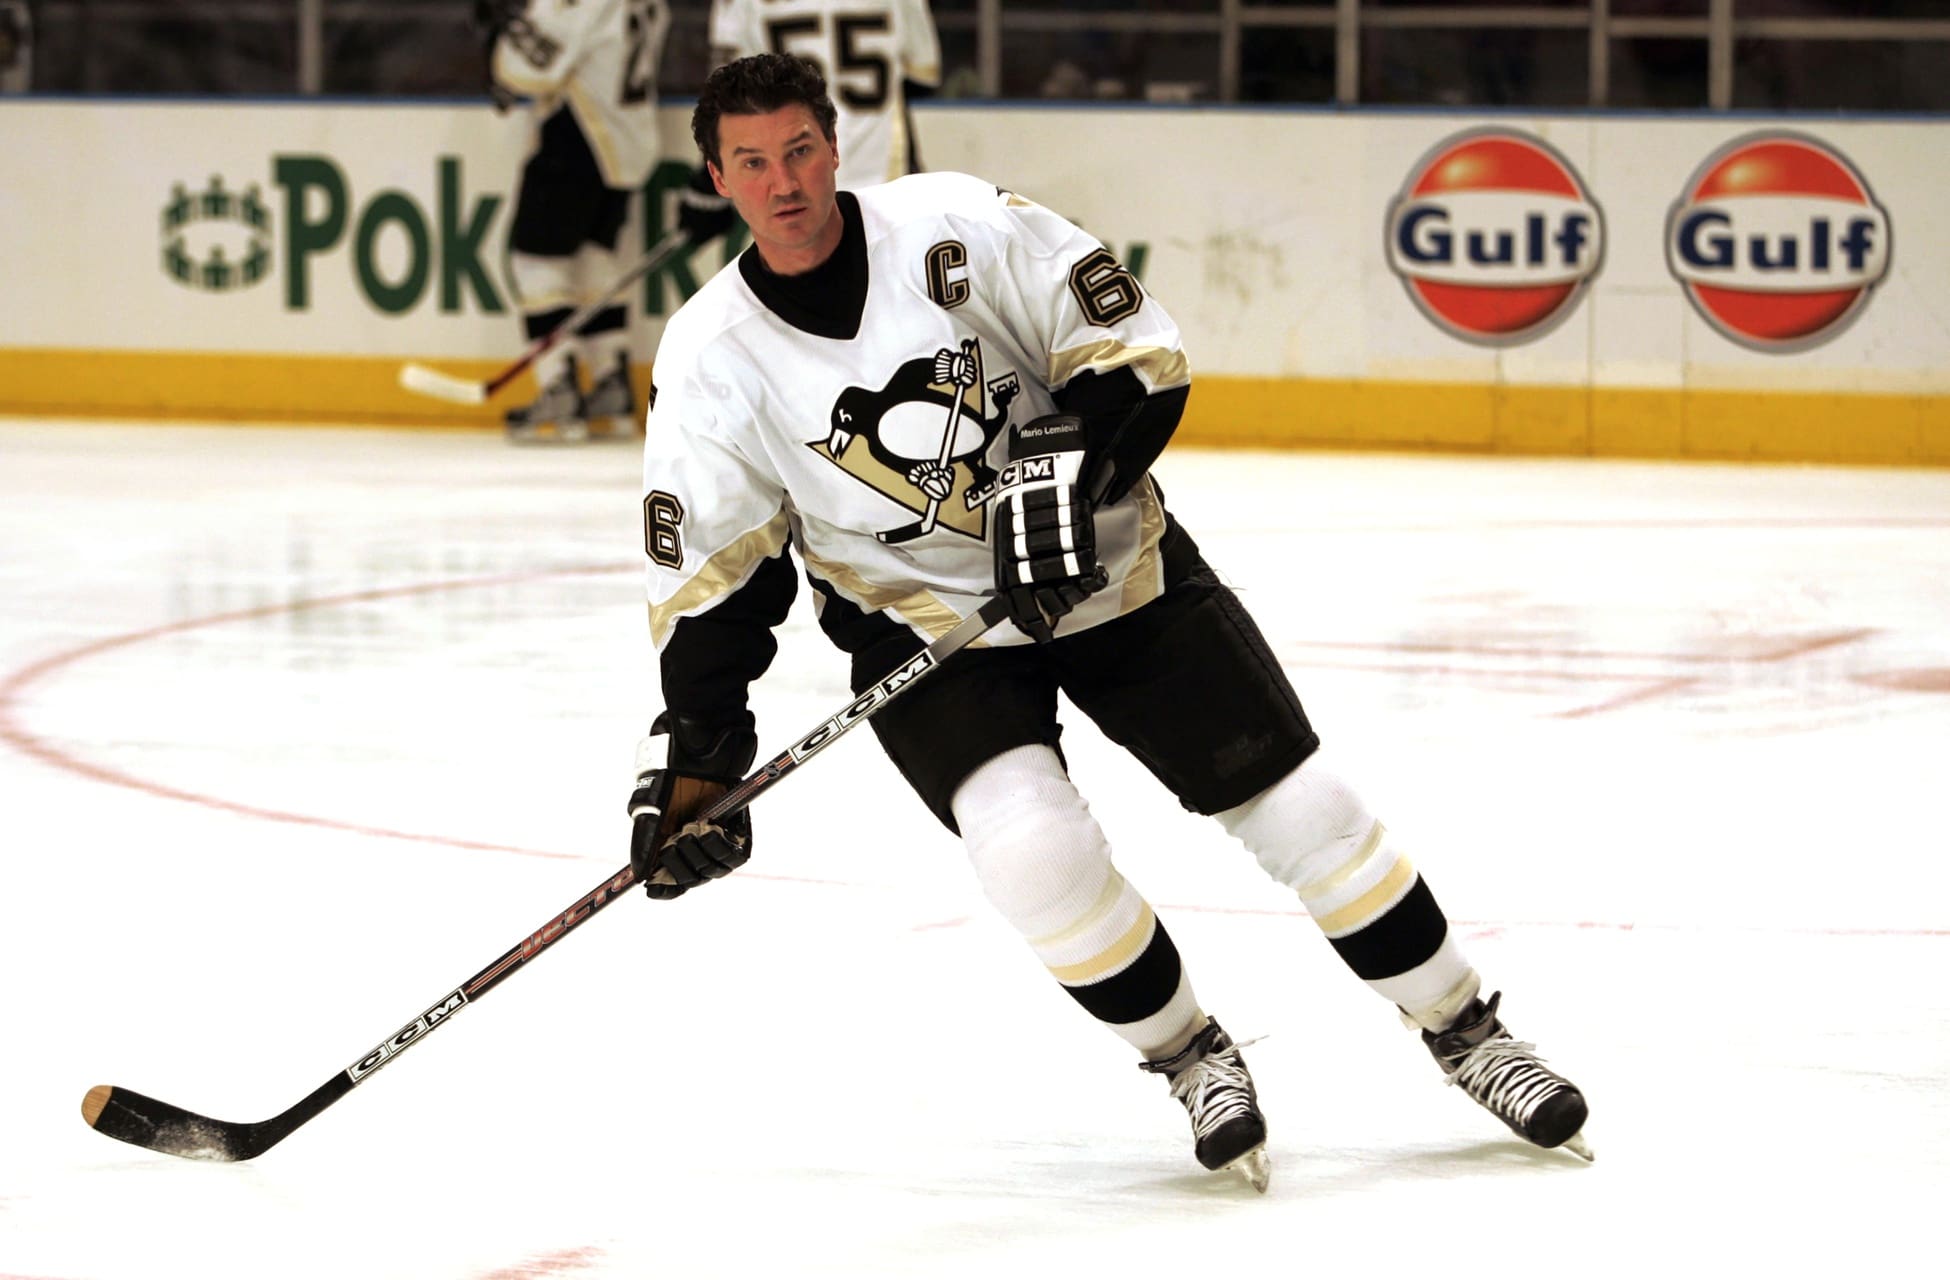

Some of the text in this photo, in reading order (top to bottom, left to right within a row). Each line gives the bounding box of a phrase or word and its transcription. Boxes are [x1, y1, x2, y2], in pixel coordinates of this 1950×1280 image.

[763, 13, 895, 112] 55
[1395, 204, 1591, 267] Gulf
[1677, 210, 1876, 271] Gulf
[925, 239, 970, 311] C
[1068, 247, 1144, 328] 6
[1020, 427, 1043, 439] Mario
[643, 489, 684, 570] 6
[800, 654, 930, 753] CCM
[357, 994, 464, 1072] CCM
